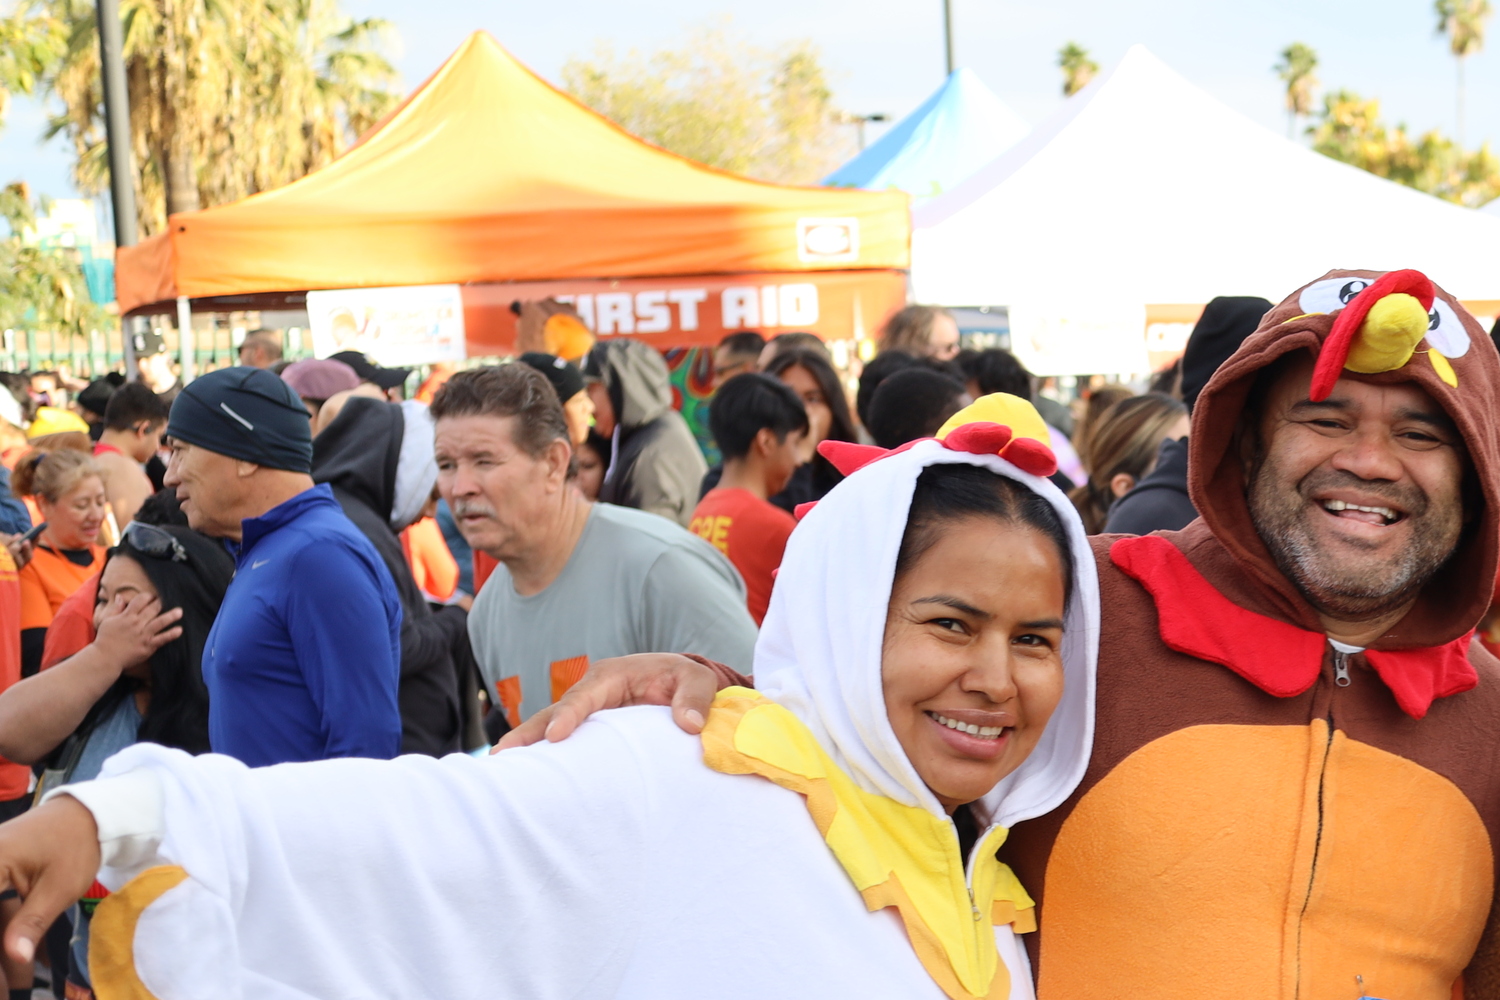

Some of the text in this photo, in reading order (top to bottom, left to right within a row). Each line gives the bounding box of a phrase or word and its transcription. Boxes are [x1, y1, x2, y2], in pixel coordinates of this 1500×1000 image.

[556, 283, 819, 335] IRST AID
[688, 515, 732, 549] OPE
